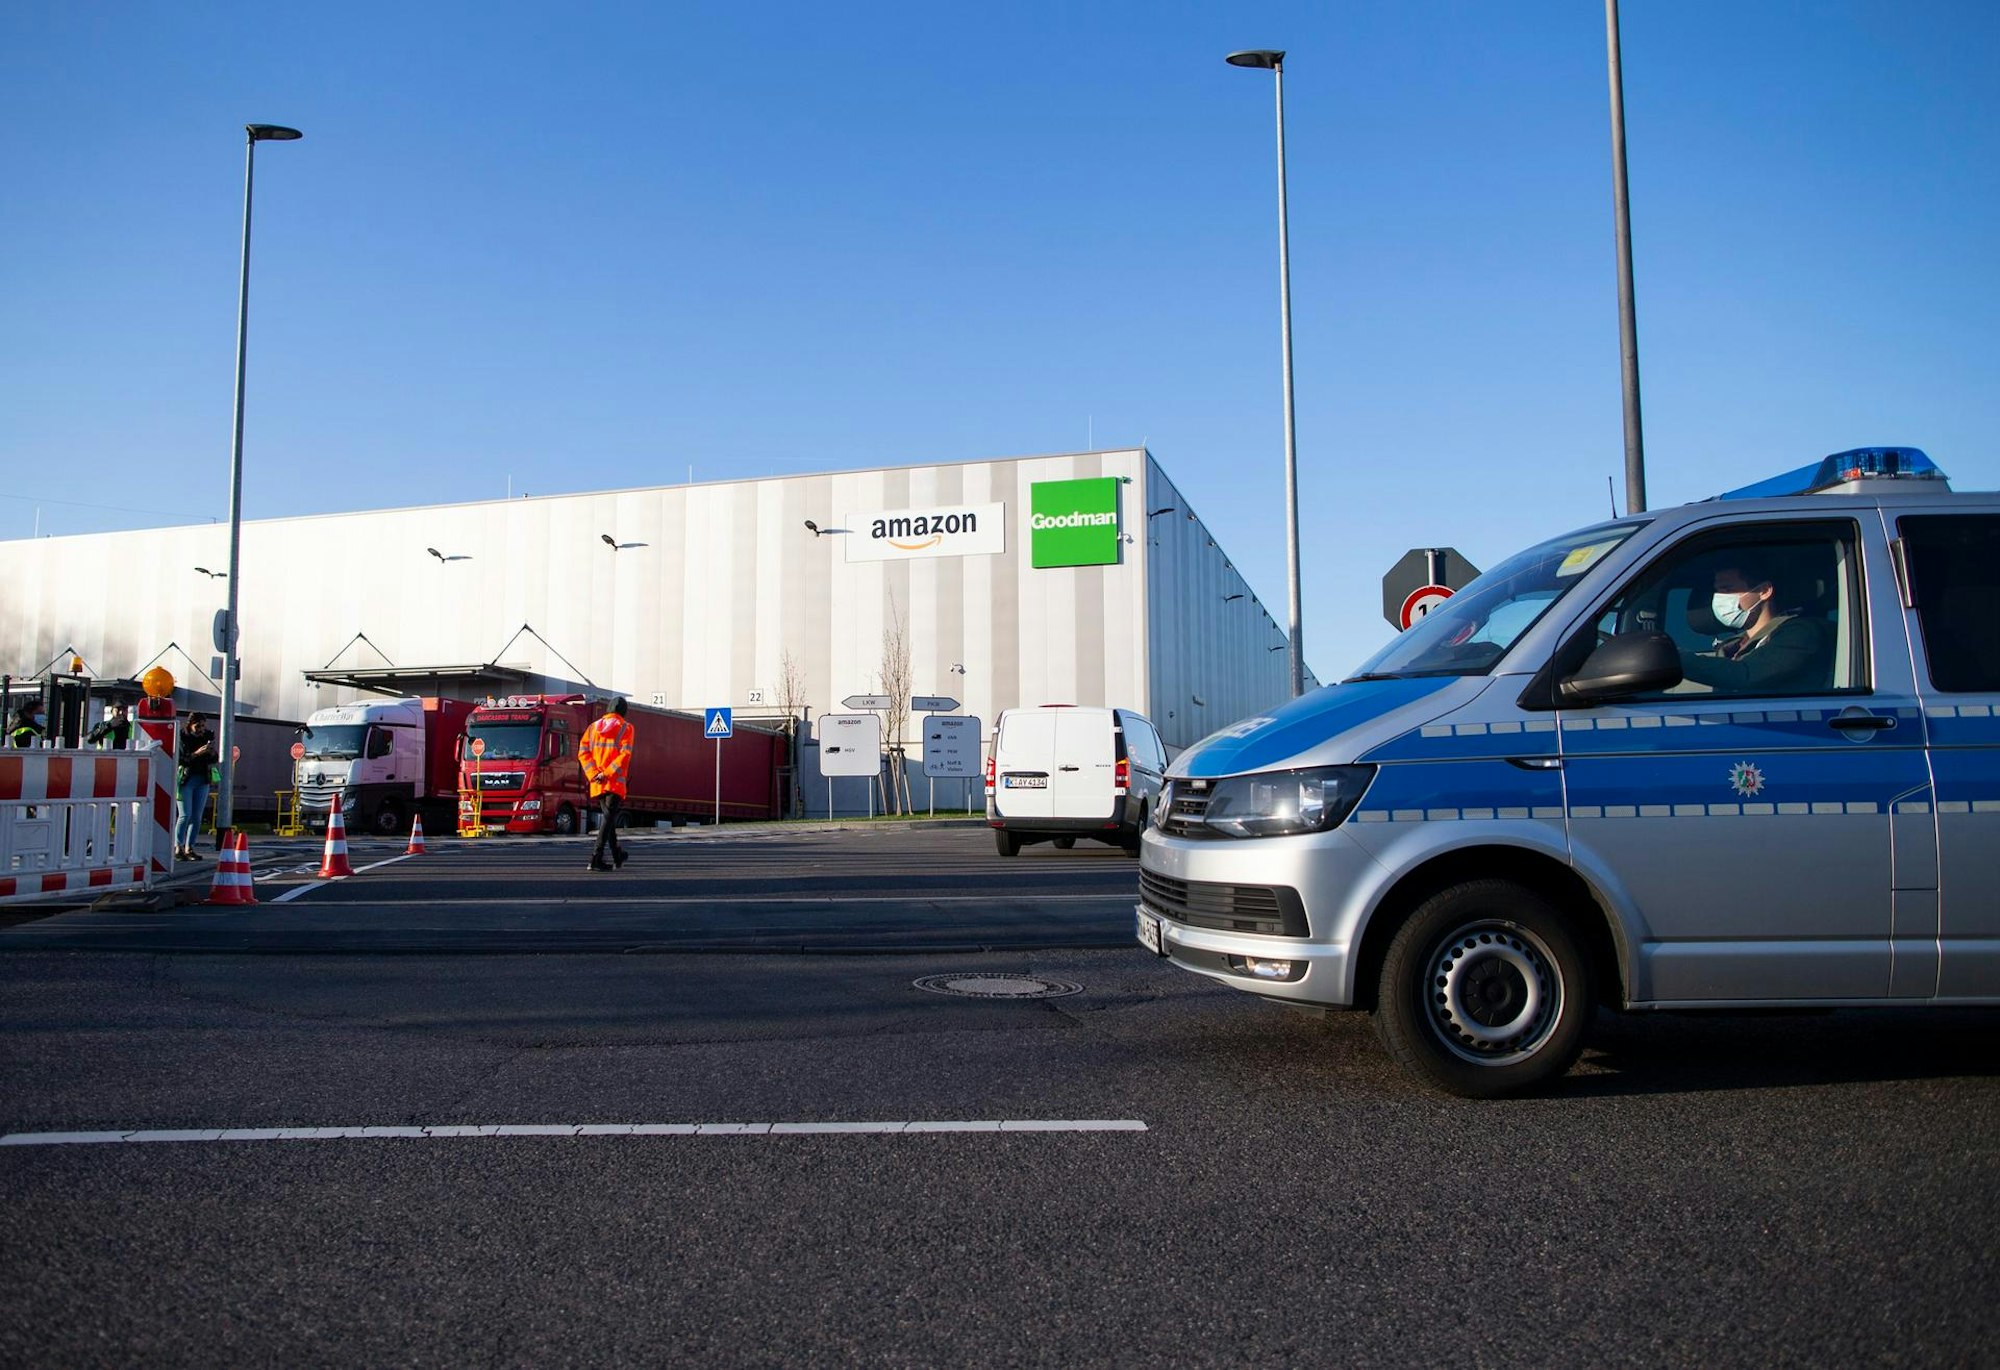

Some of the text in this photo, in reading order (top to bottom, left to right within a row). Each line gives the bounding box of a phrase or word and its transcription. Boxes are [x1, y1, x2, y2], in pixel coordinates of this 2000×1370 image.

[871, 513, 977, 539] amazon
[1031, 511, 1117, 529] Goodman
[653, 695, 664, 704] 21
[750, 693, 761, 702] 22
